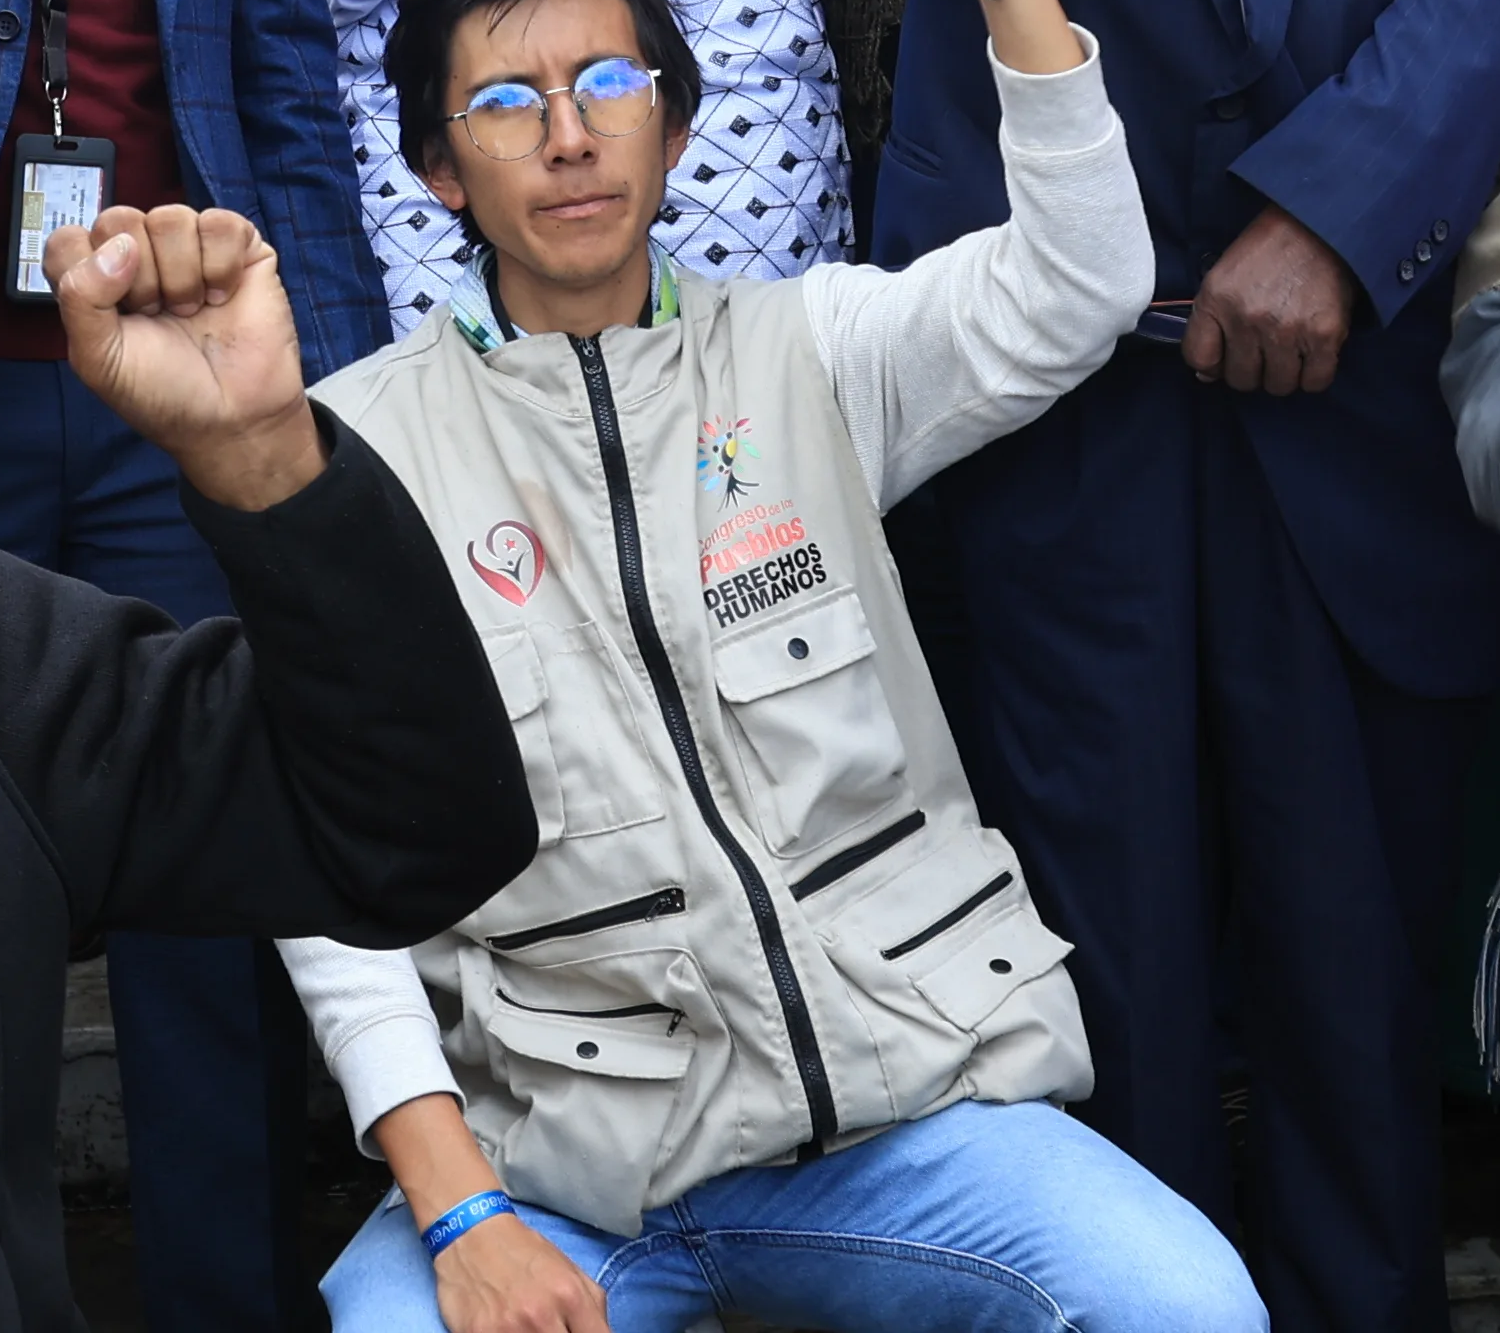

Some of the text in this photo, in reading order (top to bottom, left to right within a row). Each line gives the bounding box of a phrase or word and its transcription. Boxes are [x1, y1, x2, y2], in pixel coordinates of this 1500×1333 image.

[768, 504, 781, 515] de
[781, 499, 794, 510] los
[700, 517, 806, 585] Pueblos
[703, 543, 821, 611] DERECHOS
[714, 563, 827, 628] HUMANOS
